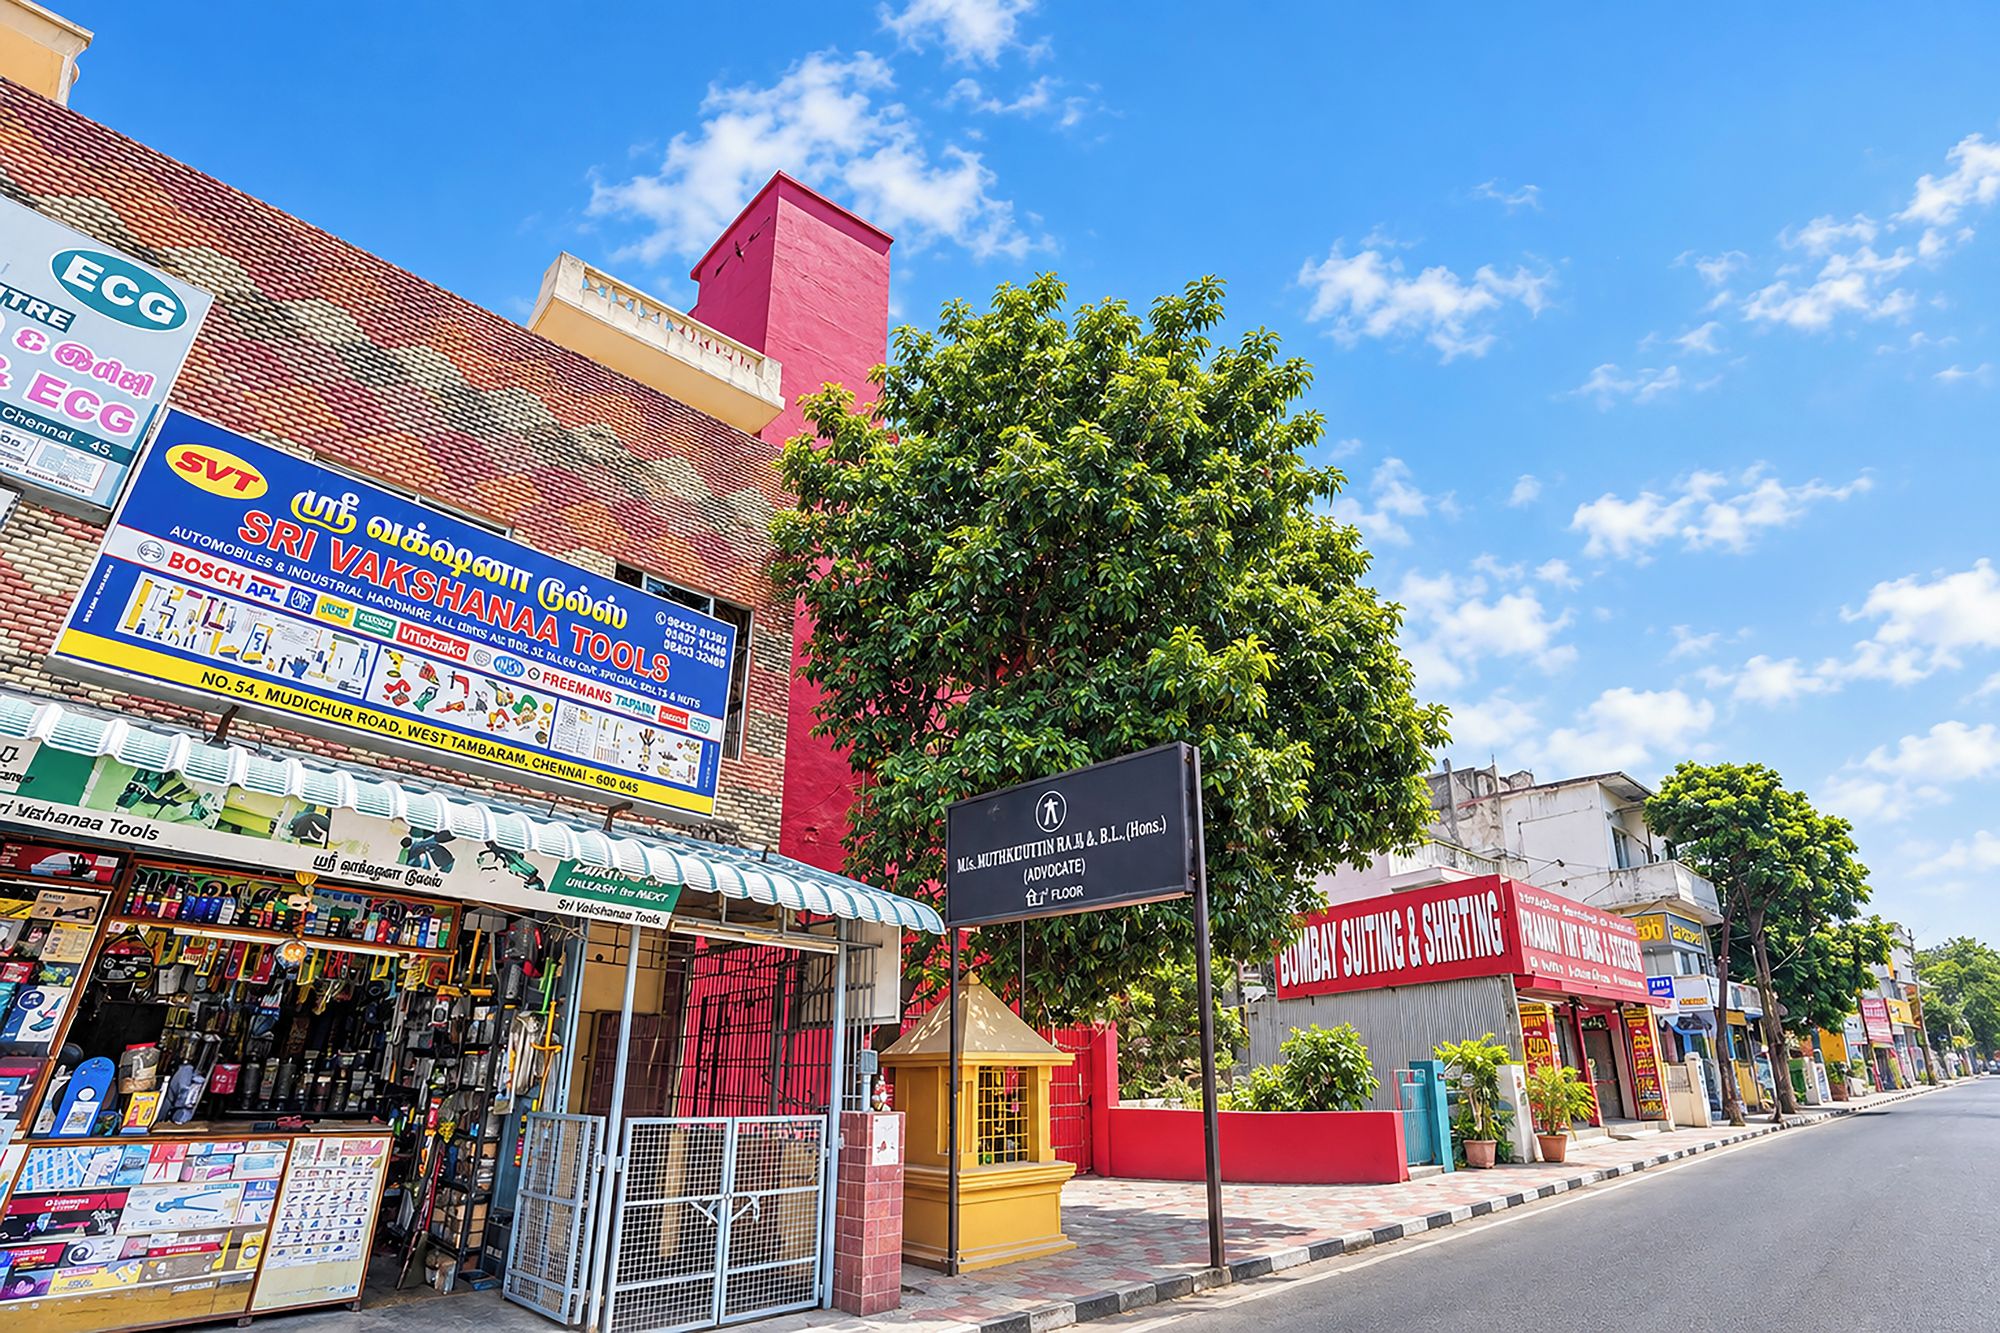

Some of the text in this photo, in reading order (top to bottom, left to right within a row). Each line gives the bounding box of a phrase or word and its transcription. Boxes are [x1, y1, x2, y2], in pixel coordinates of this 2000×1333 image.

[61, 254, 177, 326] ECG
[26, 372, 138, 434] ECG
[174, 450, 260, 493] SVT
[169, 525, 273, 569] AUTOMOBILES
[274, 562, 285, 574] &
[287, 564, 363, 600] INDUSTRIAL
[238, 509, 319, 563] SRI
[331, 536, 560, 649] VAKSHANAA
[570, 623, 671, 683] TOOLS
[167, 551, 245, 590] BOSCH
[245, 582, 281, 604] APL
[542, 671, 613, 705] FREEMANS
[265, 687, 353, 722] MUDICHUR
[408, 724, 448, 745] WEST
[532, 757, 587, 781] CHENNAI
[596, 774, 616, 788] 600
[109, 818, 160, 841] Tools
[1126, 814, 1167, 844] (Hons.)
[1023, 857, 1086, 886] (ADVOCATE)
[1050, 884, 1084, 901] FLOOR
[1279, 920, 1338, 988] BOMBAY
[1341, 908, 1405, 978] SUITING
[1406, 905, 1422, 968] &
[1422, 889, 1504, 967] SHIRTING
